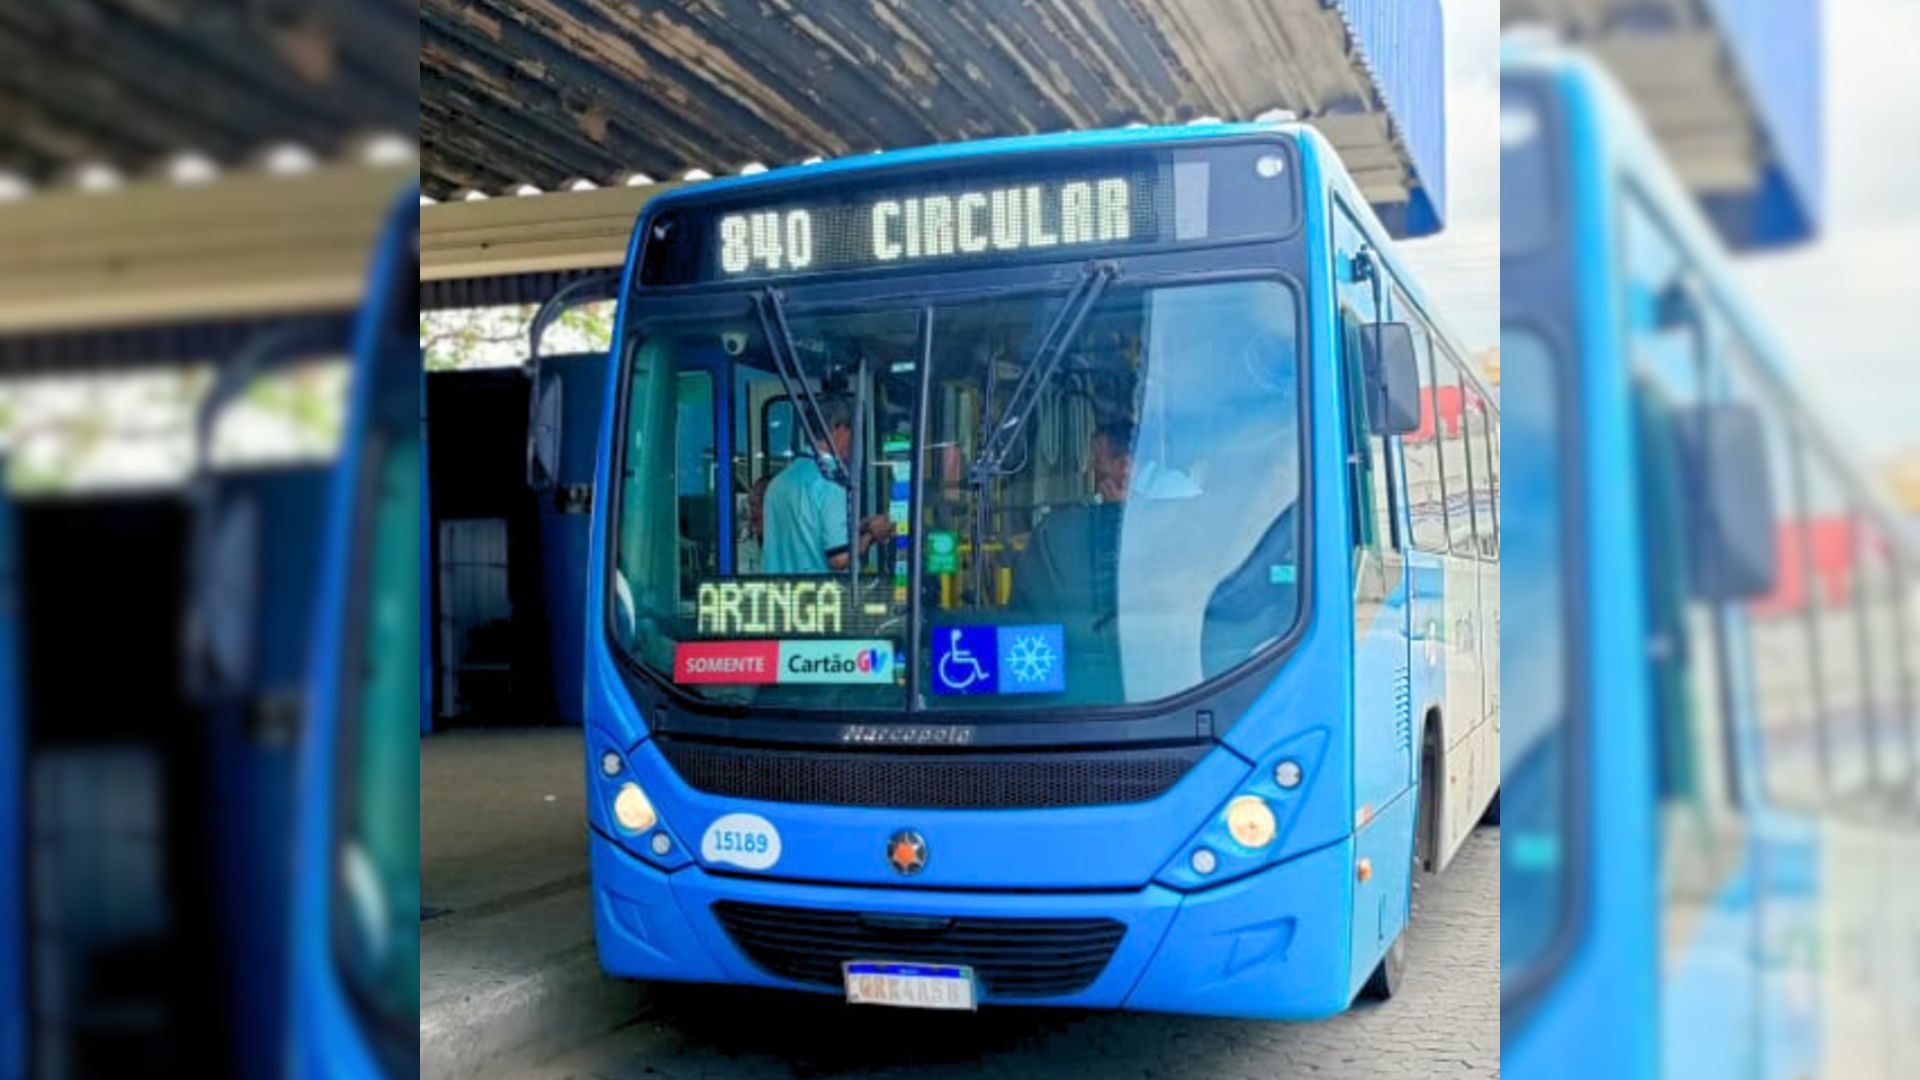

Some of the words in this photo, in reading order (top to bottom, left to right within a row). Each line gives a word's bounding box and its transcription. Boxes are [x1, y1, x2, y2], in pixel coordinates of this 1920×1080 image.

[720, 208, 813, 274] 840
[872, 177, 1131, 261] CIRCULAR
[685, 656, 765, 674] SOMENTE
[843, 724, 972, 744] Marcopolo
[714, 829, 768, 854] 15189
